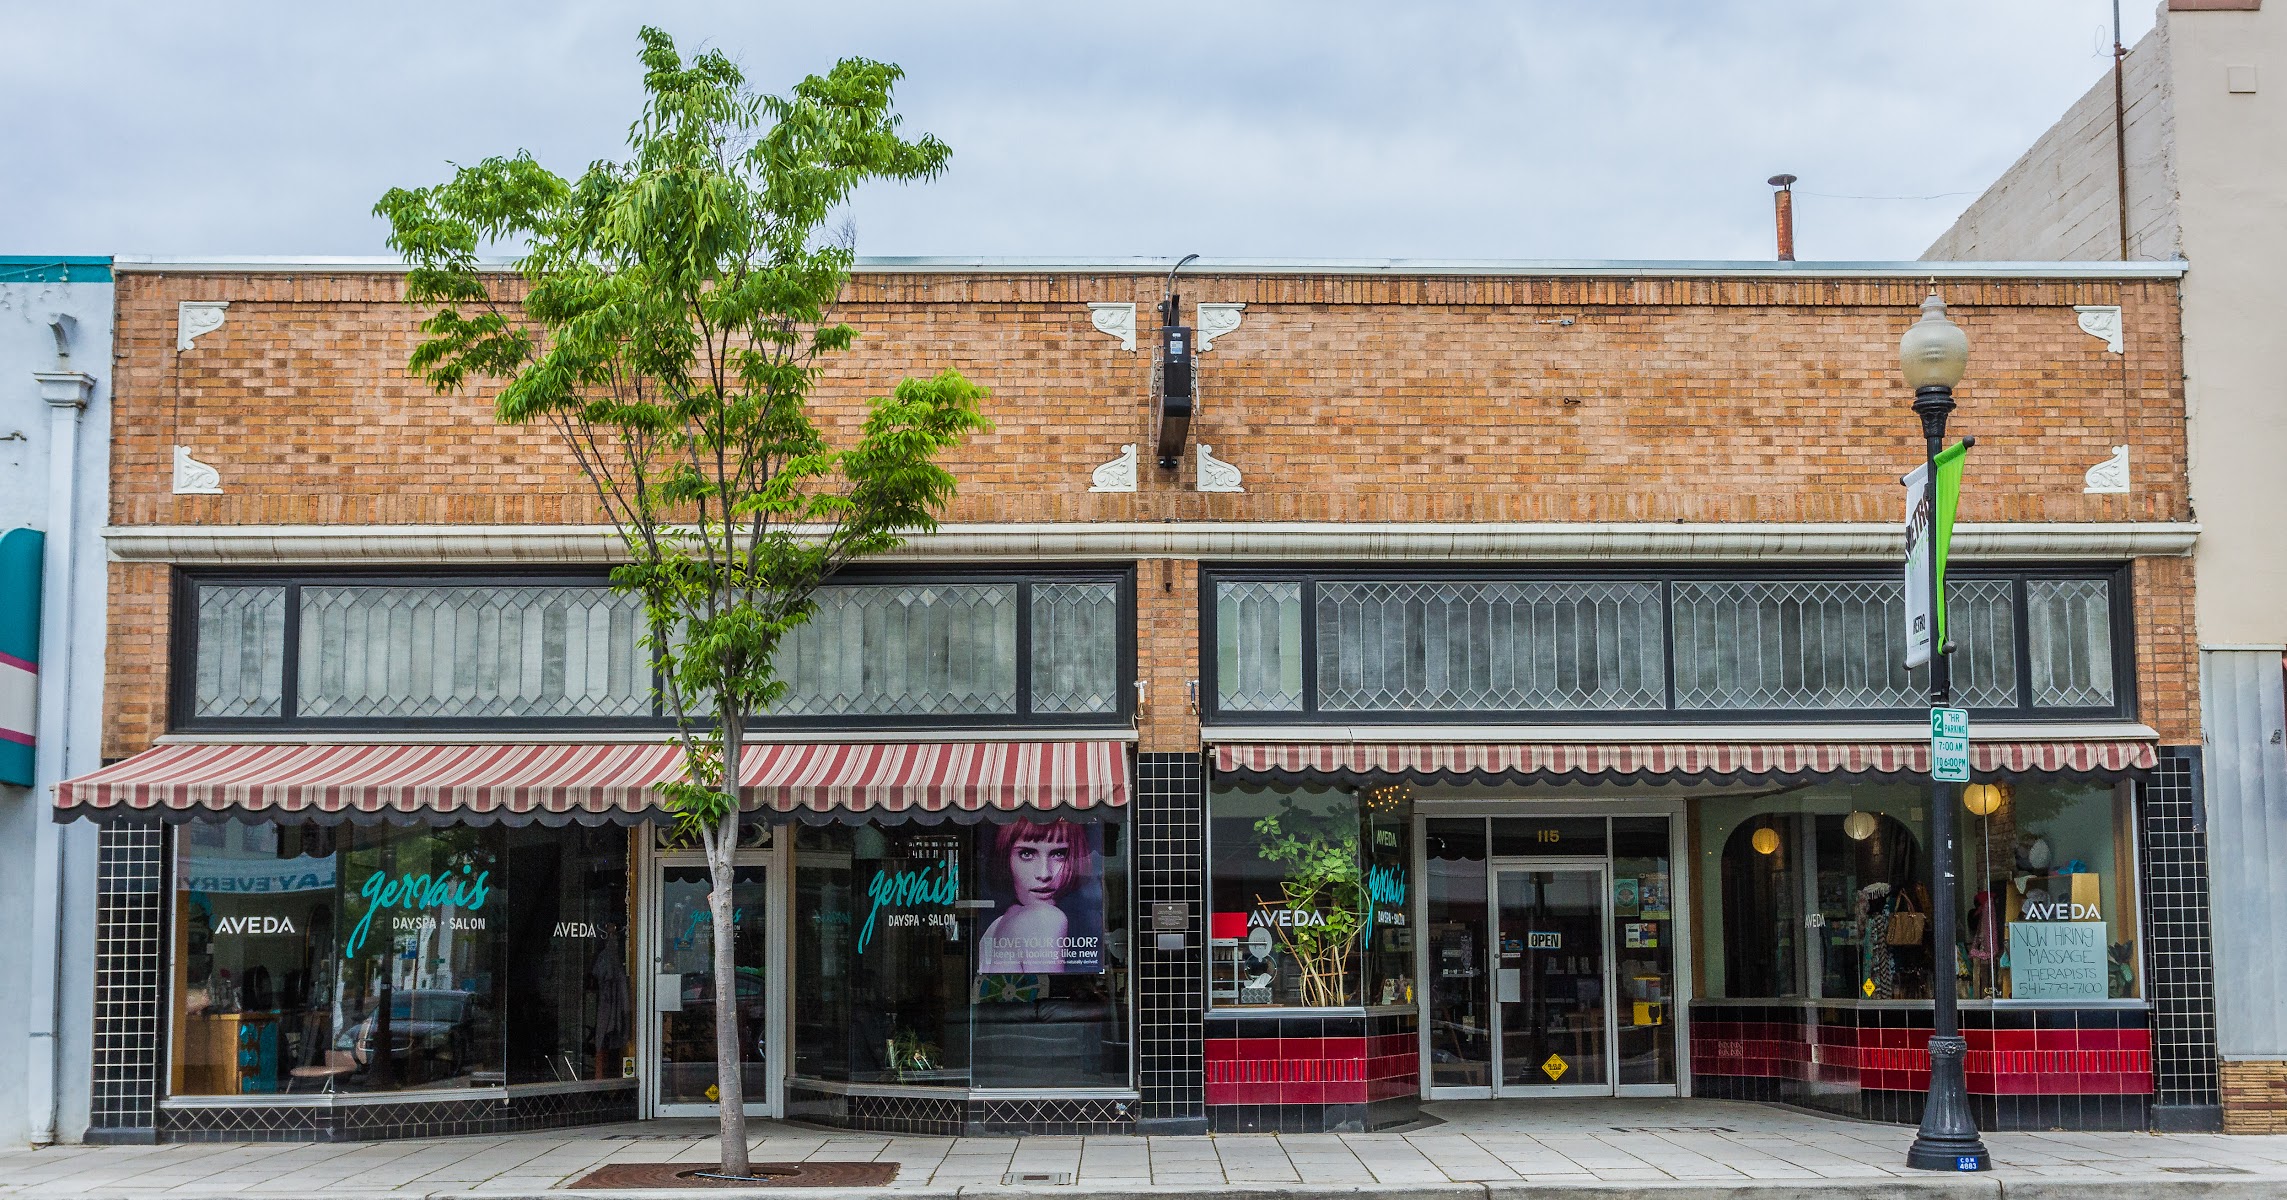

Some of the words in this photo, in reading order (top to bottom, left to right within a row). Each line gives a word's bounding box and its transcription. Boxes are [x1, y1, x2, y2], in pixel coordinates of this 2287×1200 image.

[1934, 713, 1942, 732] 2
[1950, 714, 1960, 722] HR
[1945, 725, 1965, 734] PARKING
[1938, 741, 1954, 751] 7:00
[1955, 742, 1963, 752] AM
[1936, 757, 1943, 767] TO
[1958, 758, 1966, 768] PM
[1376, 830, 1397, 847] AVEDA
[1538, 829, 1560, 843] 115
[346, 865, 489, 958] gervais
[858, 860, 959, 954] gervais
[1365, 863, 1405, 949] gervais
[2025, 903, 2102, 920] AVEDA
[215, 916, 296, 934] AVEDA
[392, 917, 437, 930] DAYSPA
[449, 917, 486, 930] SALON
[888, 914, 920, 927] DAYSPA
[928, 913, 956, 926] SALON
[1247, 910, 1325, 927] AVEDA
[1805, 913, 1826, 928] AVEDA
[553, 922, 597, 938] AVEDA
[2012, 924, 2048, 948] NOW
[993, 937, 1021, 948] LOVE
[1023, 937, 1053, 948] YOUR
[1056, 936, 1099, 948] COLOR?
[1531, 933, 1559, 948] OPEN
[993, 949, 1015, 960] keep
[1017, 949, 1024, 958] it
[1026, 948, 1059, 960] looking
[1061, 948, 1077, 958] like
[1079, 950, 1099, 958] new
[2028, 948, 2096, 965] MASSAGE
[2022, 967, 2097, 981] THERAPISTS
[2019, 982, 2103, 996] 541-779-7100
